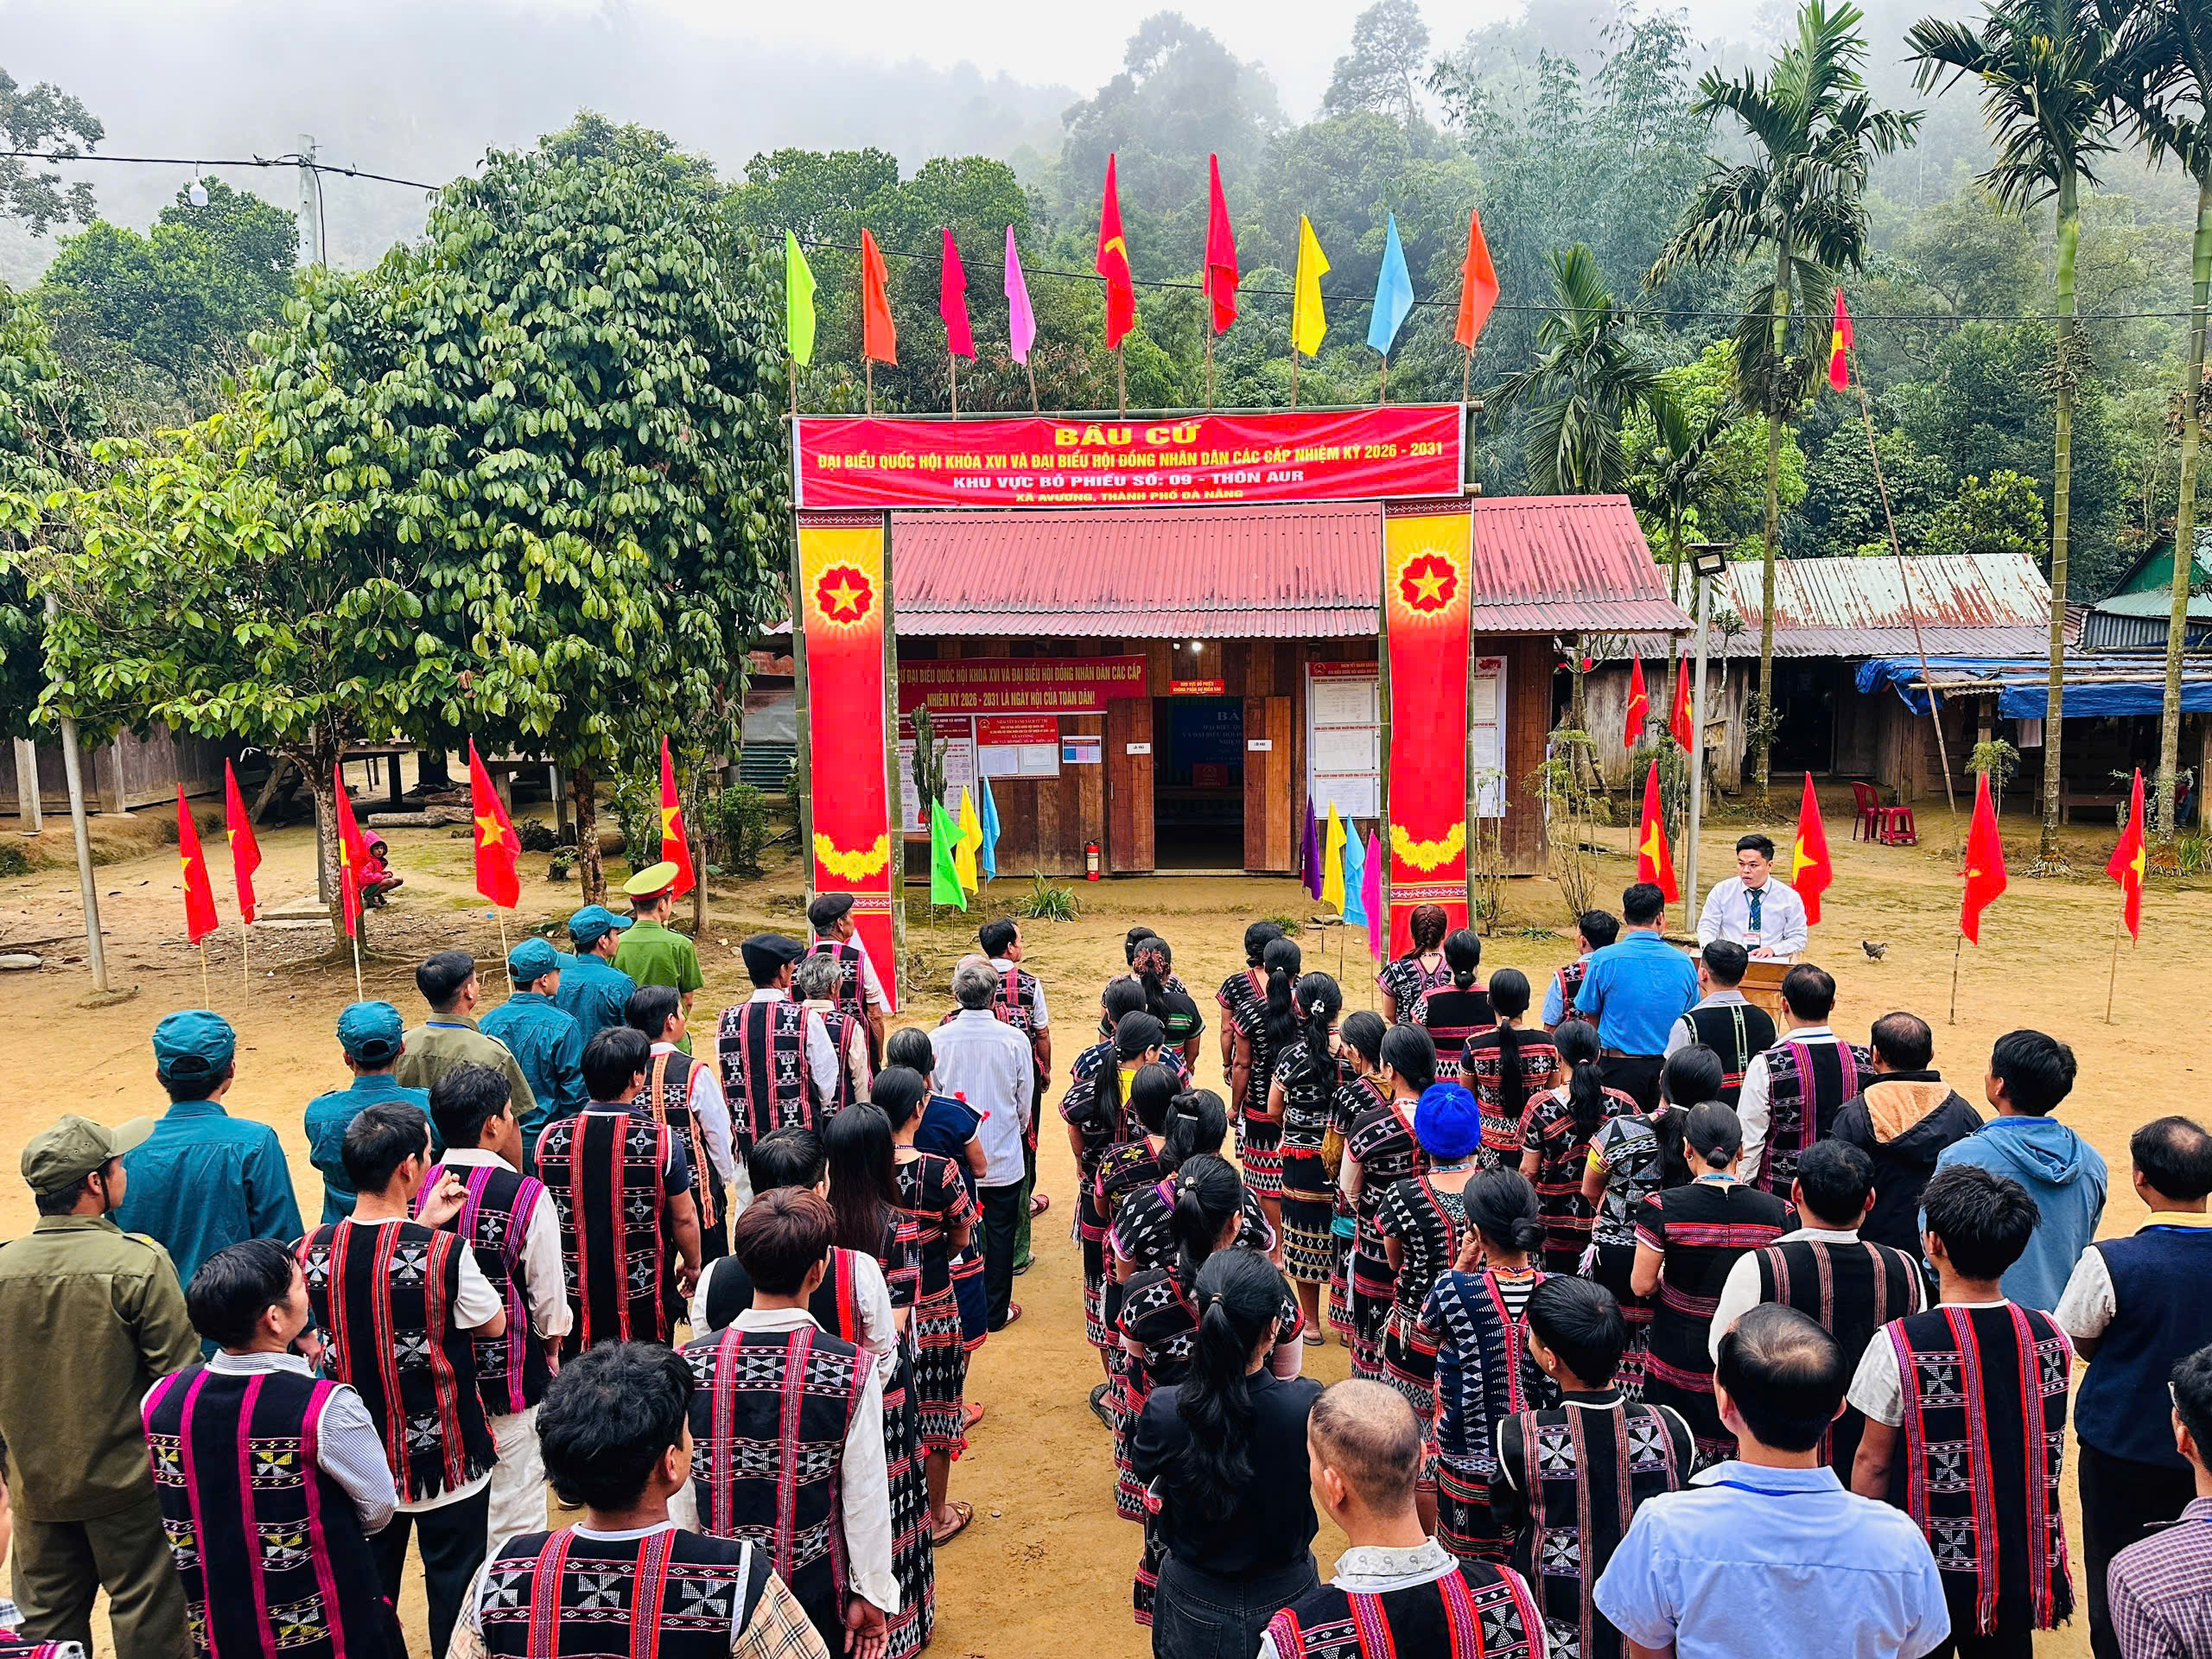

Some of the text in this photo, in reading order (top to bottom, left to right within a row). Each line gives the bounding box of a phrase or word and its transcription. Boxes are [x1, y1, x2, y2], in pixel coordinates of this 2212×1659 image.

[1146, 422, 1201, 445] CỬ
[818, 454, 840, 471] ĐẠI
[845, 450, 875, 468] BIỂU
[880, 451, 915, 469] QUỐC
[919, 453, 941, 471] HỘI
[945, 452, 982, 469] KHÓA
[986, 454, 1007, 468] XVI
[1011, 452, 1027, 467] VÀ
[1032, 454, 1053, 470] ĐẠI
[1058, 450, 1088, 468] BIỂU
[1093, 451, 1115, 470] HỘI
[1119, 449, 1155, 467] ĐỒNG
[1160, 450, 1197, 467] NHÂN
[1201, 449, 1228, 465] DÂN
[1233, 448, 1259, 464] CÁC
[1264, 444, 1291, 463] CẤP
[1295, 447, 1338, 463] NHIỆM
[1344, 443, 1361, 460] KỲ
[1364, 443, 1397, 459] 2026
[1410, 442, 1442, 456] 2031
[954, 476, 991, 488] KHU
[997, 475, 1033, 490] VỰC
[1039, 474, 1065, 487] BỎ
[1071, 472, 1127, 486] PHIẾU
[1132, 472, 1163, 486] SỐ:
[1169, 474, 1192, 486] 09
[1211, 469, 1260, 484] THÔN
[1267, 470, 1304, 482] AUR
[1016, 492, 1034, 502] XÃ
[1102, 490, 1146, 501] THÀNH
[1150, 489, 1178, 500] PHỐ
[1182, 489, 1200, 499] ĐÀ
[907, 669, 918, 686] ĐẠI
[919, 663, 935, 683] BIỂU
[937, 663, 955, 683] QUỐC
[957, 665, 968, 685] HỘI
[969, 664, 987, 683] KHÓA
[988, 668, 1000, 683] XVI
[1001, 664, 1010, 683] VÀ
[1012, 667, 1023, 685] ĐẠI
[1025, 661, 1040, 682] BIỂU
[1042, 664, 1053, 684] HỘI
[1055, 662, 1073, 682] ĐỒNG
[1075, 664, 1095, 681] NHÂN
[1096, 663, 1110, 681] DÂN
[1112, 663, 1126, 680] CÁC
[1128, 660, 1141, 681] CẤP
[926, 690, 949, 709] NHIỆM
[950, 690, 959, 707] KỲ
[961, 692, 977, 707] 2026
[983, 692, 999, 707] 2031
[1001, 689, 1009, 706] LÀ
[1011, 689, 1029, 706] NGÀY
[1031, 688, 1042, 709] HỘI
[1044, 686, 1058, 706] CỦA
[1058, 688, 1077, 705] TOÀN
[1078, 688, 1096, 705] DÂN!
